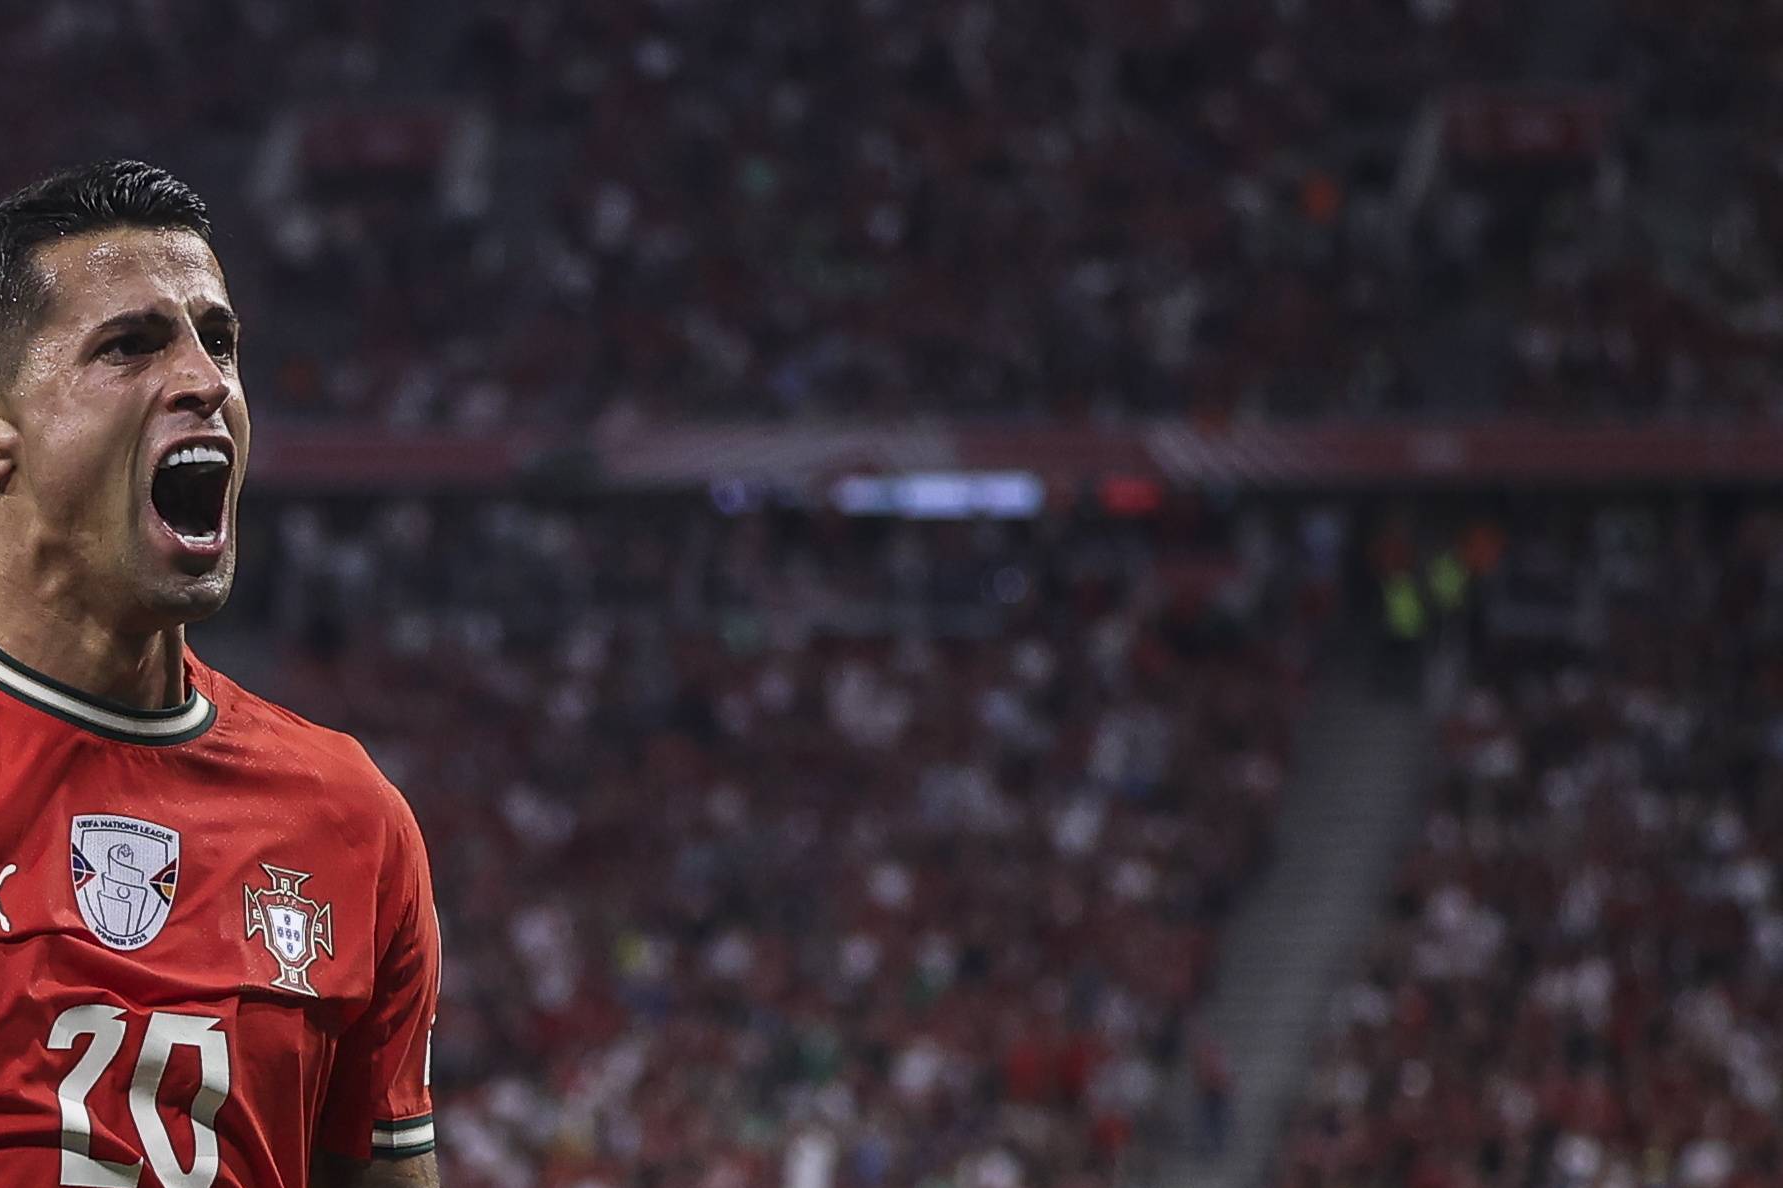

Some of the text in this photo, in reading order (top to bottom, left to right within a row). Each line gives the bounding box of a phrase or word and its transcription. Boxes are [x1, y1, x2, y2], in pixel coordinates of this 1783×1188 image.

[77, 820, 174, 842] UEFA NATIONS LEAGUE
[95, 926, 148, 945] WINNER 2025
